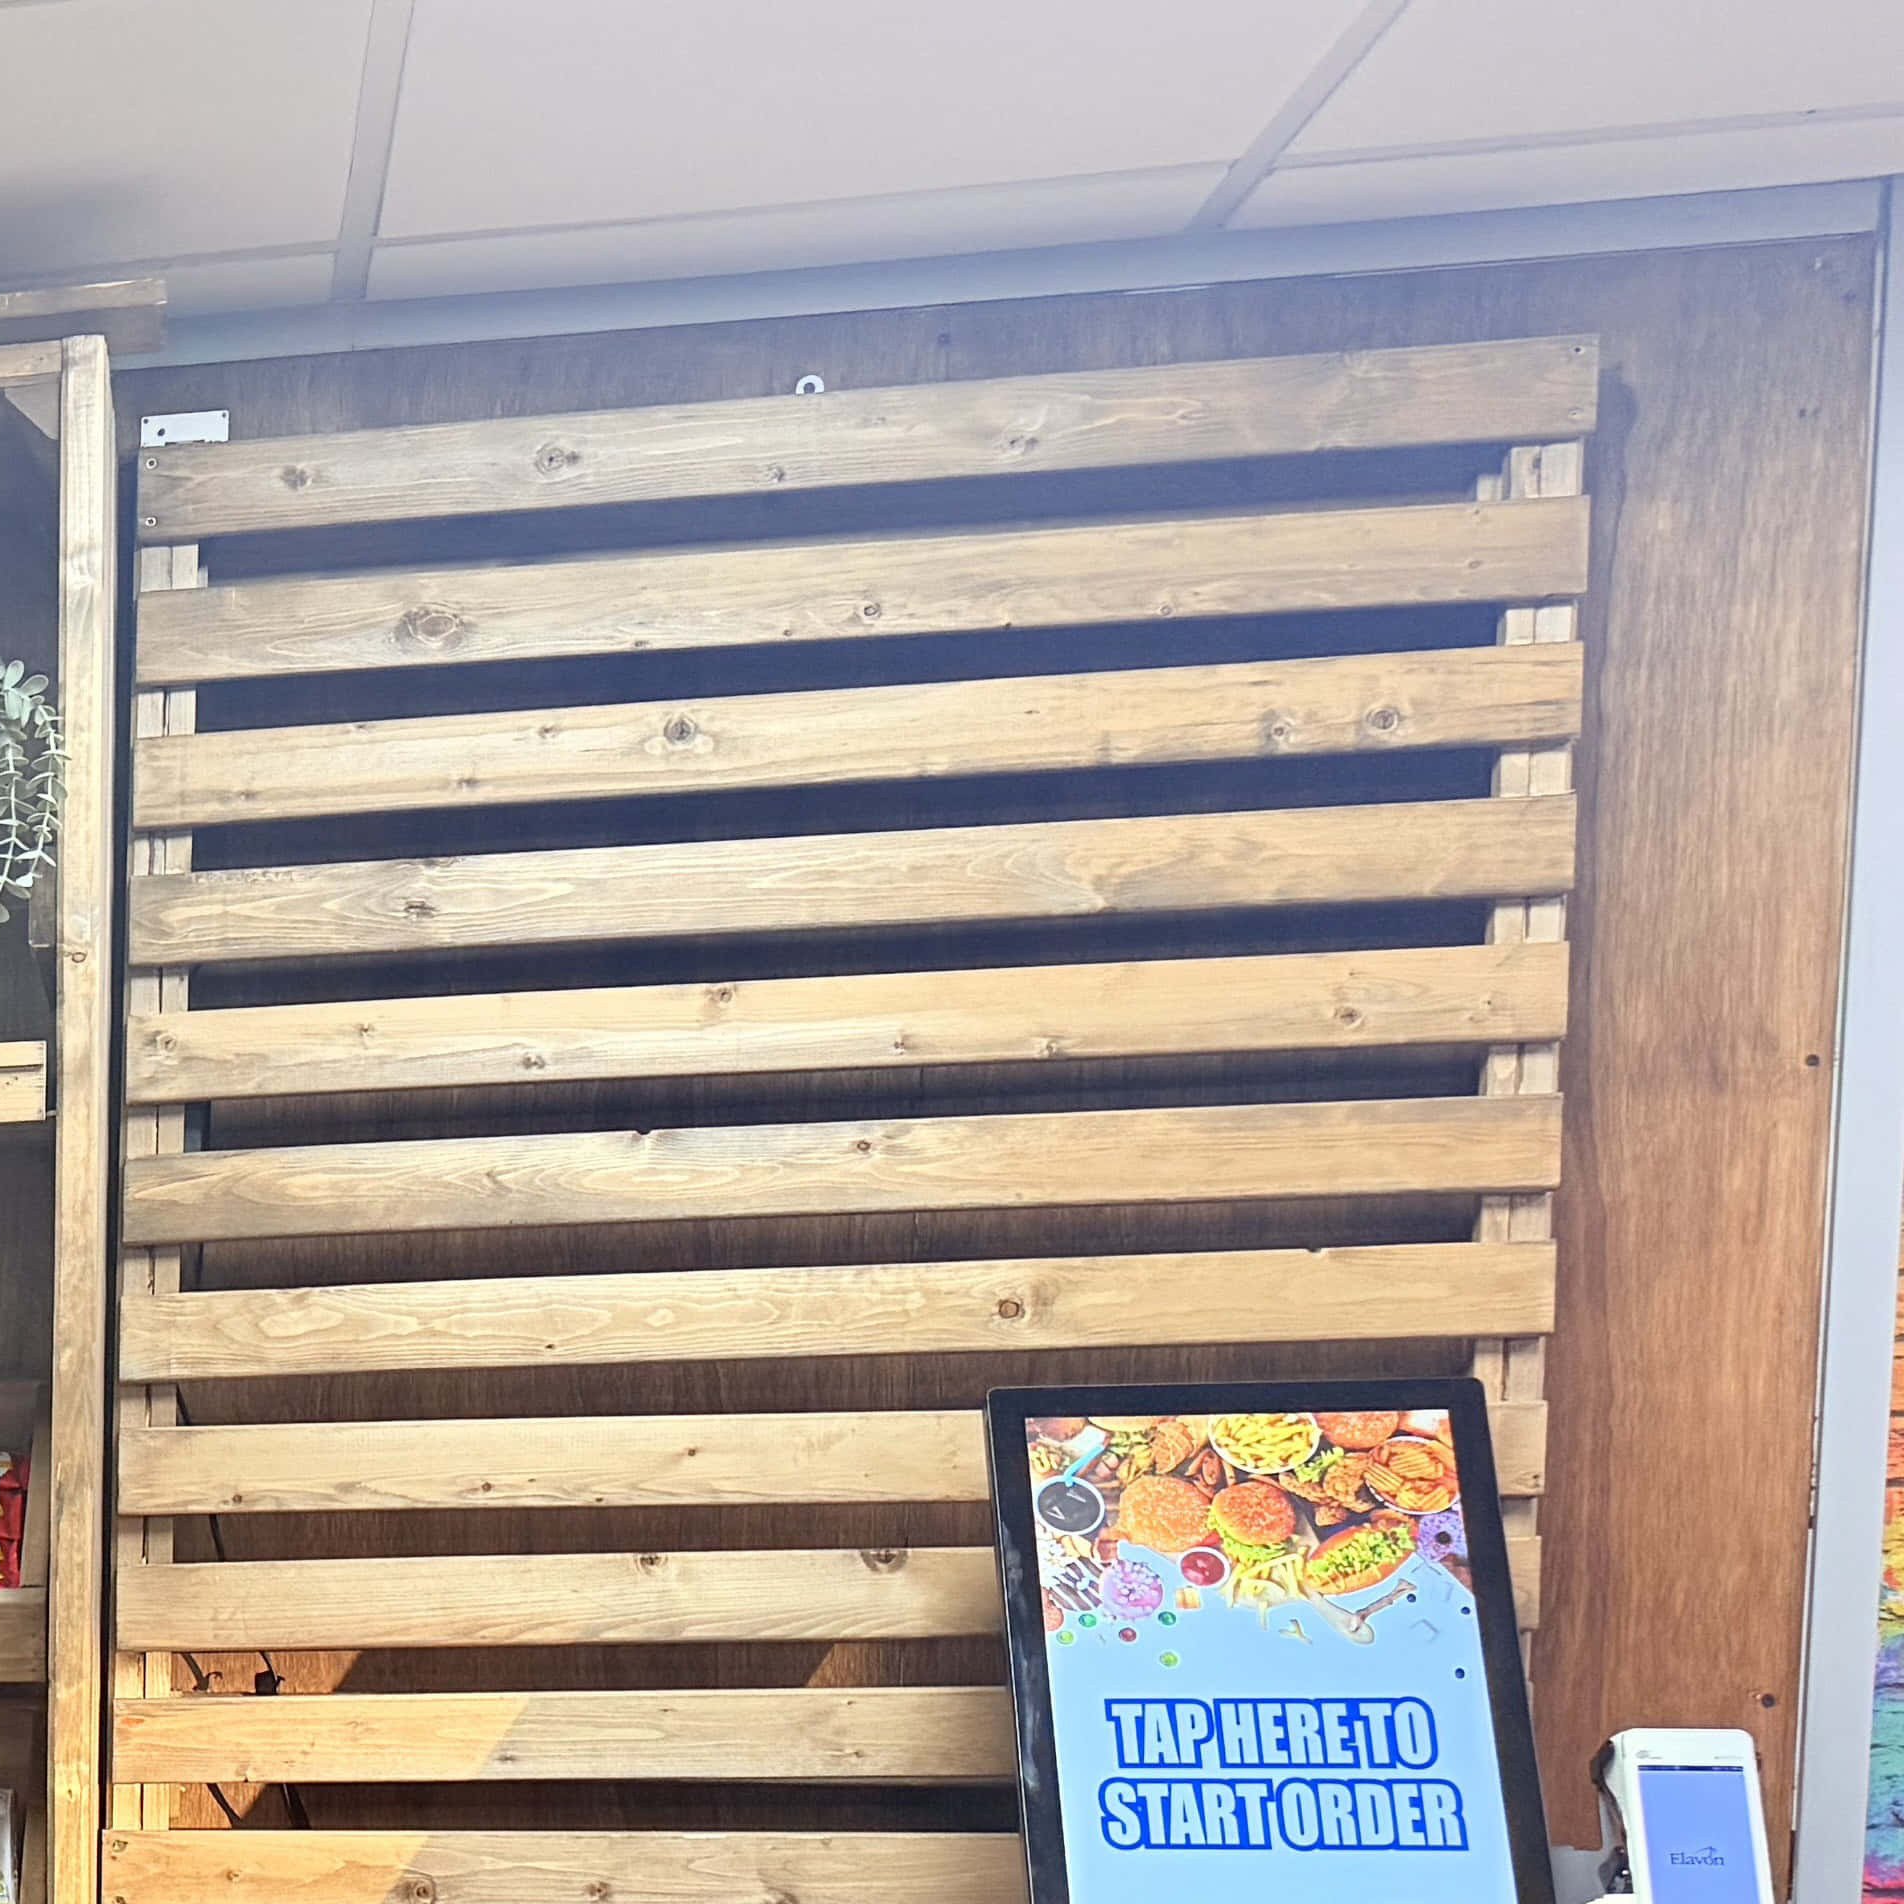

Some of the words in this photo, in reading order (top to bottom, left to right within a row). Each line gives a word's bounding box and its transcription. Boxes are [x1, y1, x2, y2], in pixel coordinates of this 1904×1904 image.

[1106, 1698, 1211, 1769] TAP
[1214, 1698, 1359, 1769] HERE
[1355, 1697, 1439, 1769] TO
[1099, 1778, 1275, 1850] START
[1276, 1778, 1470, 1850] ORDER
[1669, 1850, 1725, 1867] Elavon
